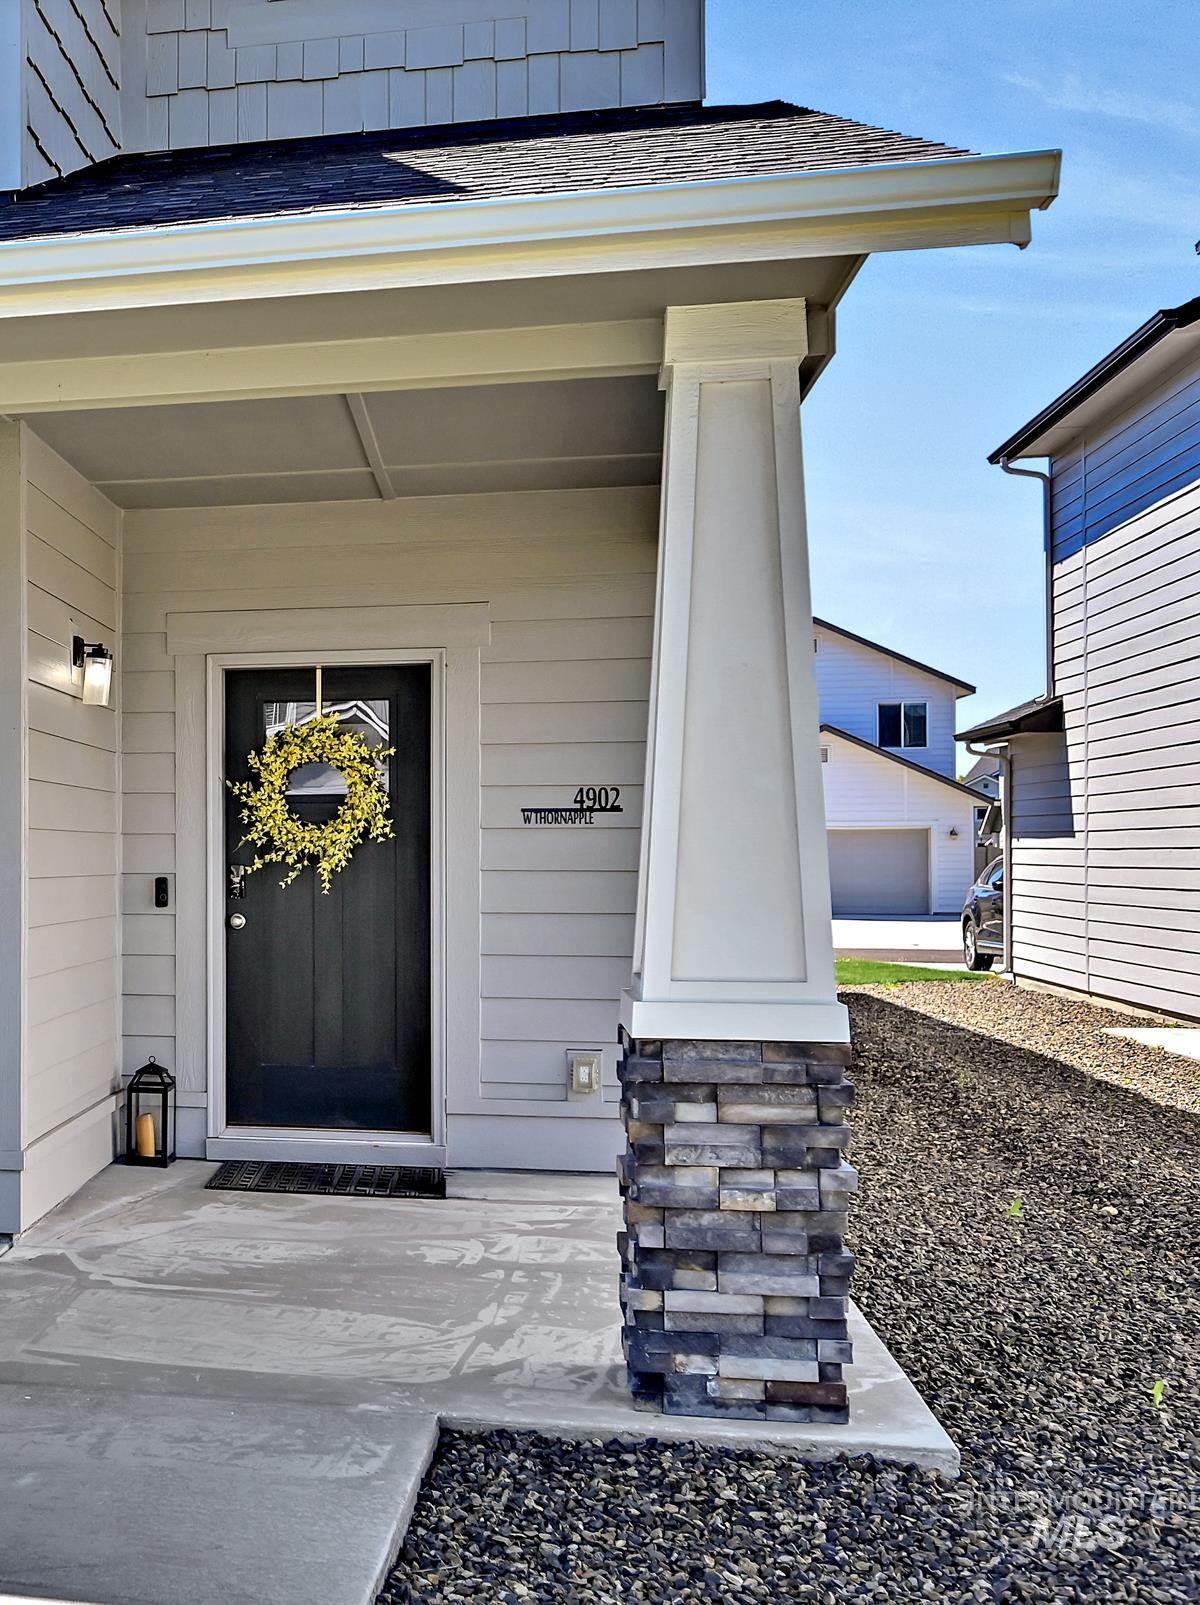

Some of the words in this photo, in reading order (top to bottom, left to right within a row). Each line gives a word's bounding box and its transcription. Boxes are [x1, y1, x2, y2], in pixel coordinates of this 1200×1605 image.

[573, 787, 621, 810] 4902
[522, 811, 533, 825] W
[534, 811, 595, 825] THORNAPPLE
